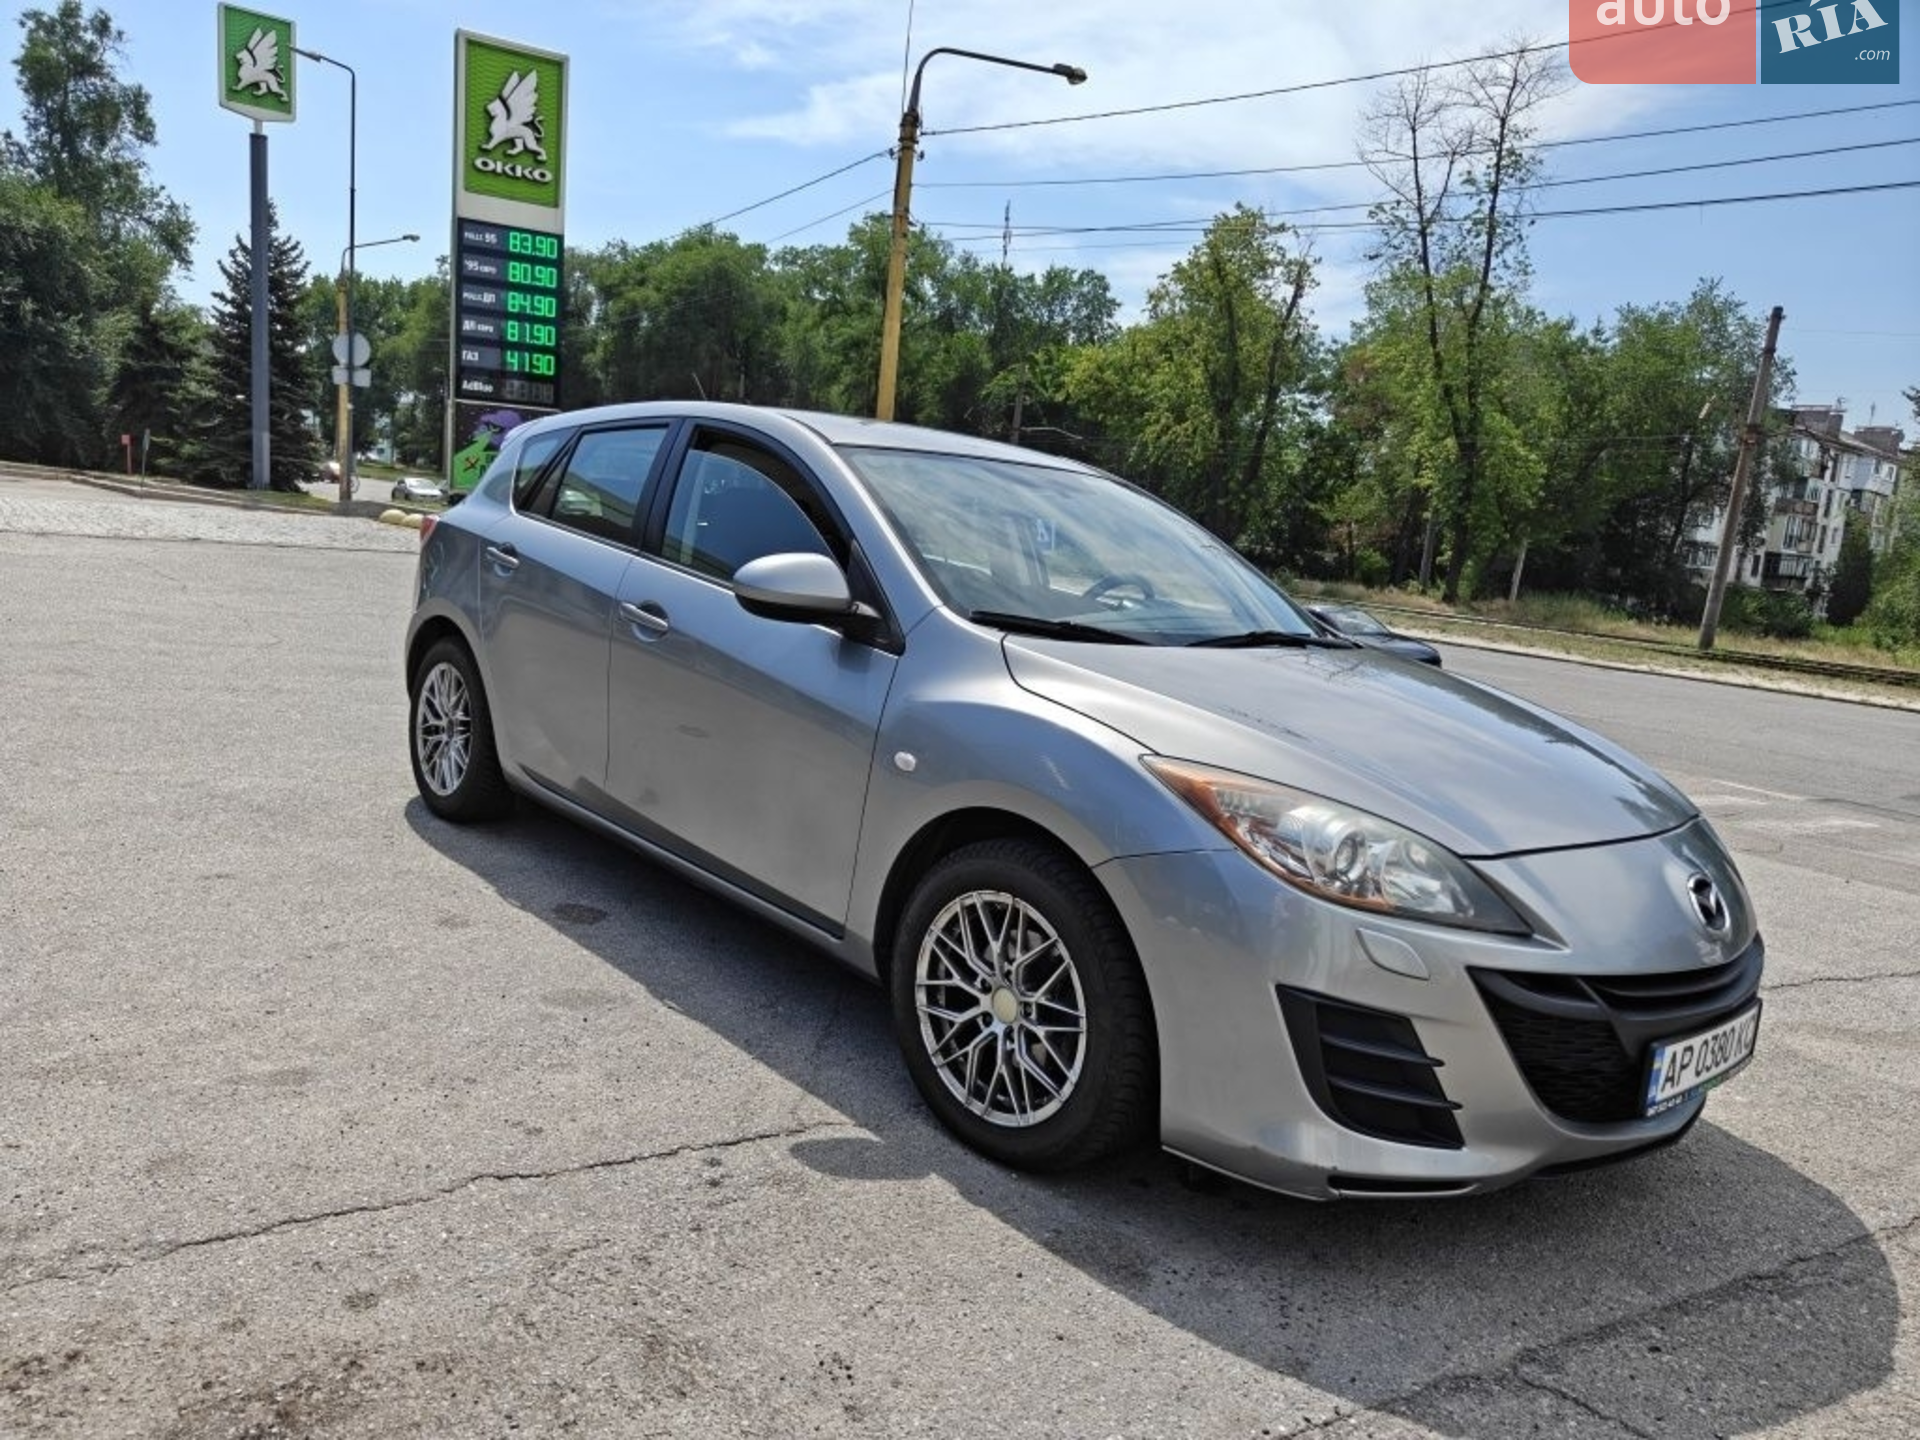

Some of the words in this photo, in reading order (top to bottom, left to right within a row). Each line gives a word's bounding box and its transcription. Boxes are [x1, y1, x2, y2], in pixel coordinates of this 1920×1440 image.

[474, 157, 552, 182] OKKO
[509, 231, 558, 259] 83.90
[508, 261, 557, 288] 80.90
[508, 291, 556, 318] 84.90
[507, 320, 556, 346] 81.90
[462, 349, 479, 361] ГАЗ
[1661, 1045, 1694, 1093] AP
